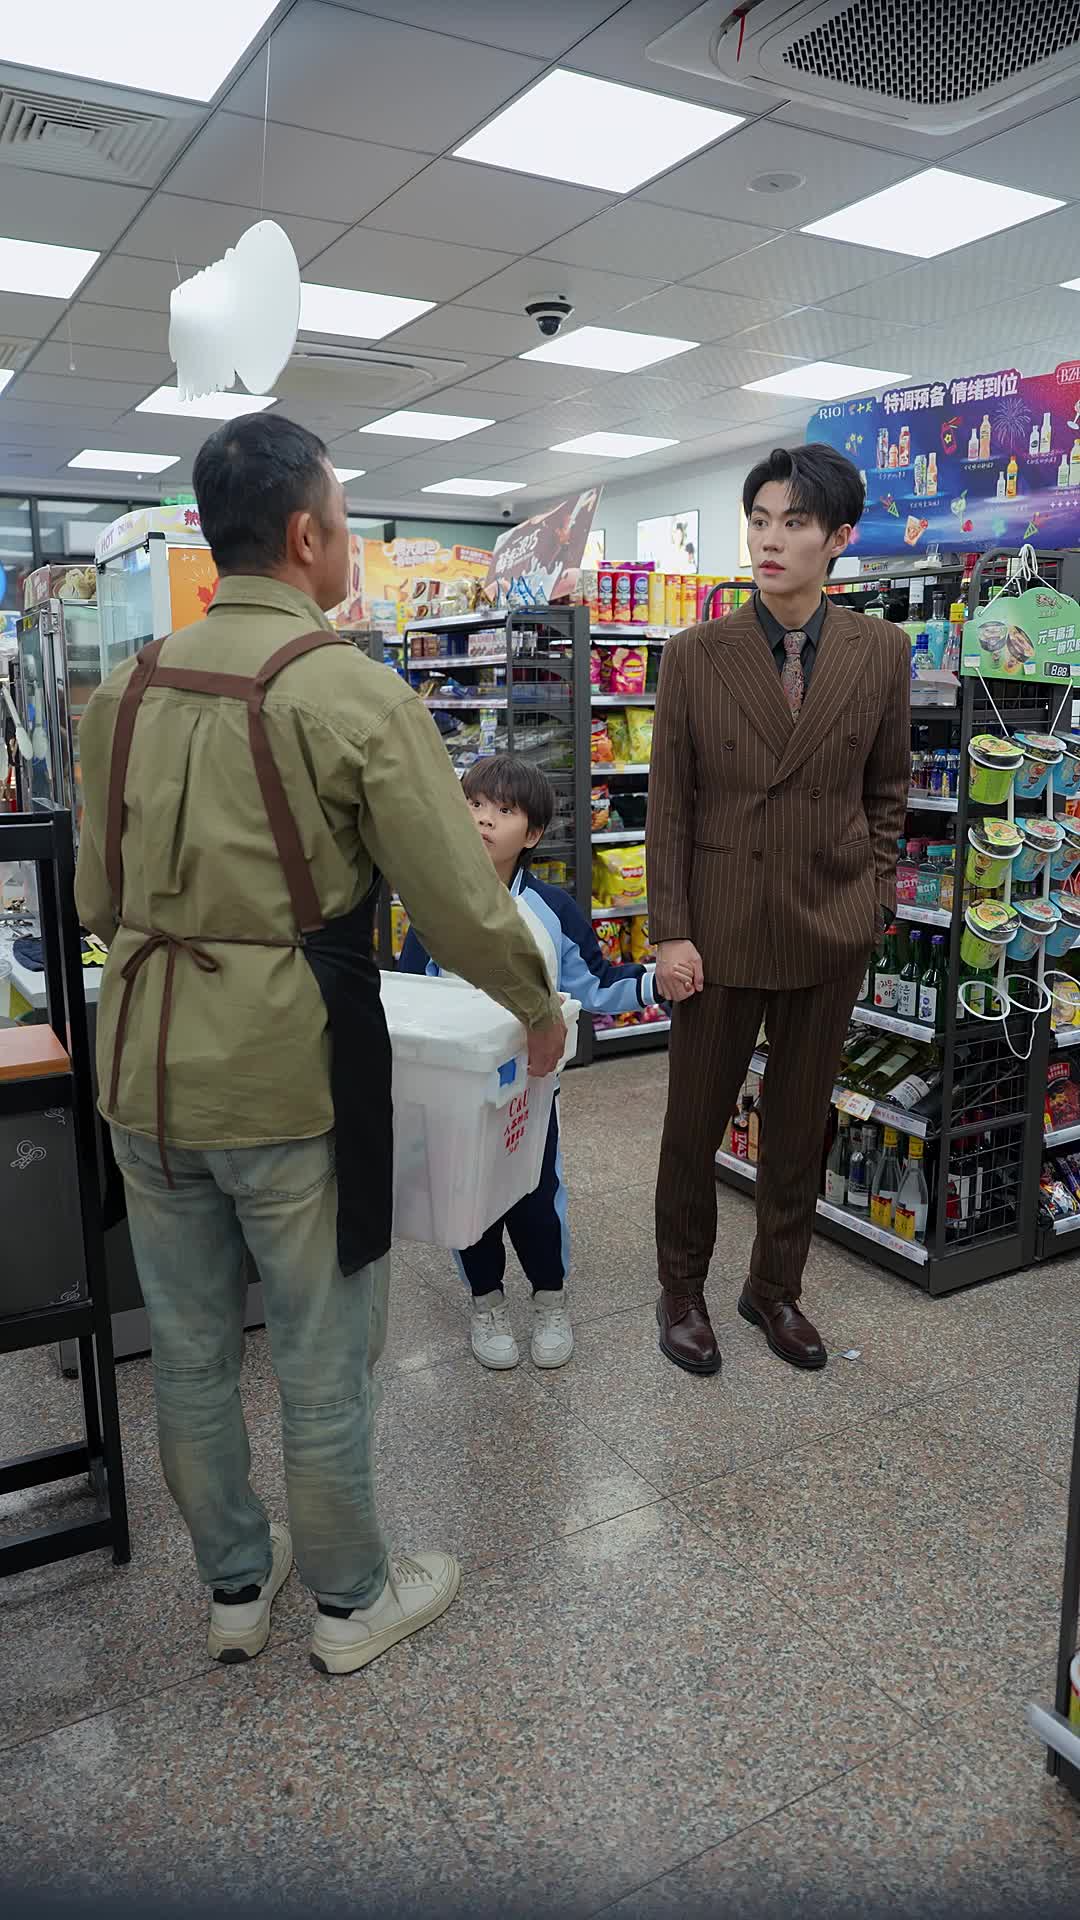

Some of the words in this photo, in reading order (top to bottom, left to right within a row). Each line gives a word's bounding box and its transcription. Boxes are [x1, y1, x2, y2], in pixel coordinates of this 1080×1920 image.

[884, 385, 946, 414] 特调预备
[950, 373, 1018, 404] 情绪到位
[819, 405, 841, 420] RIO
